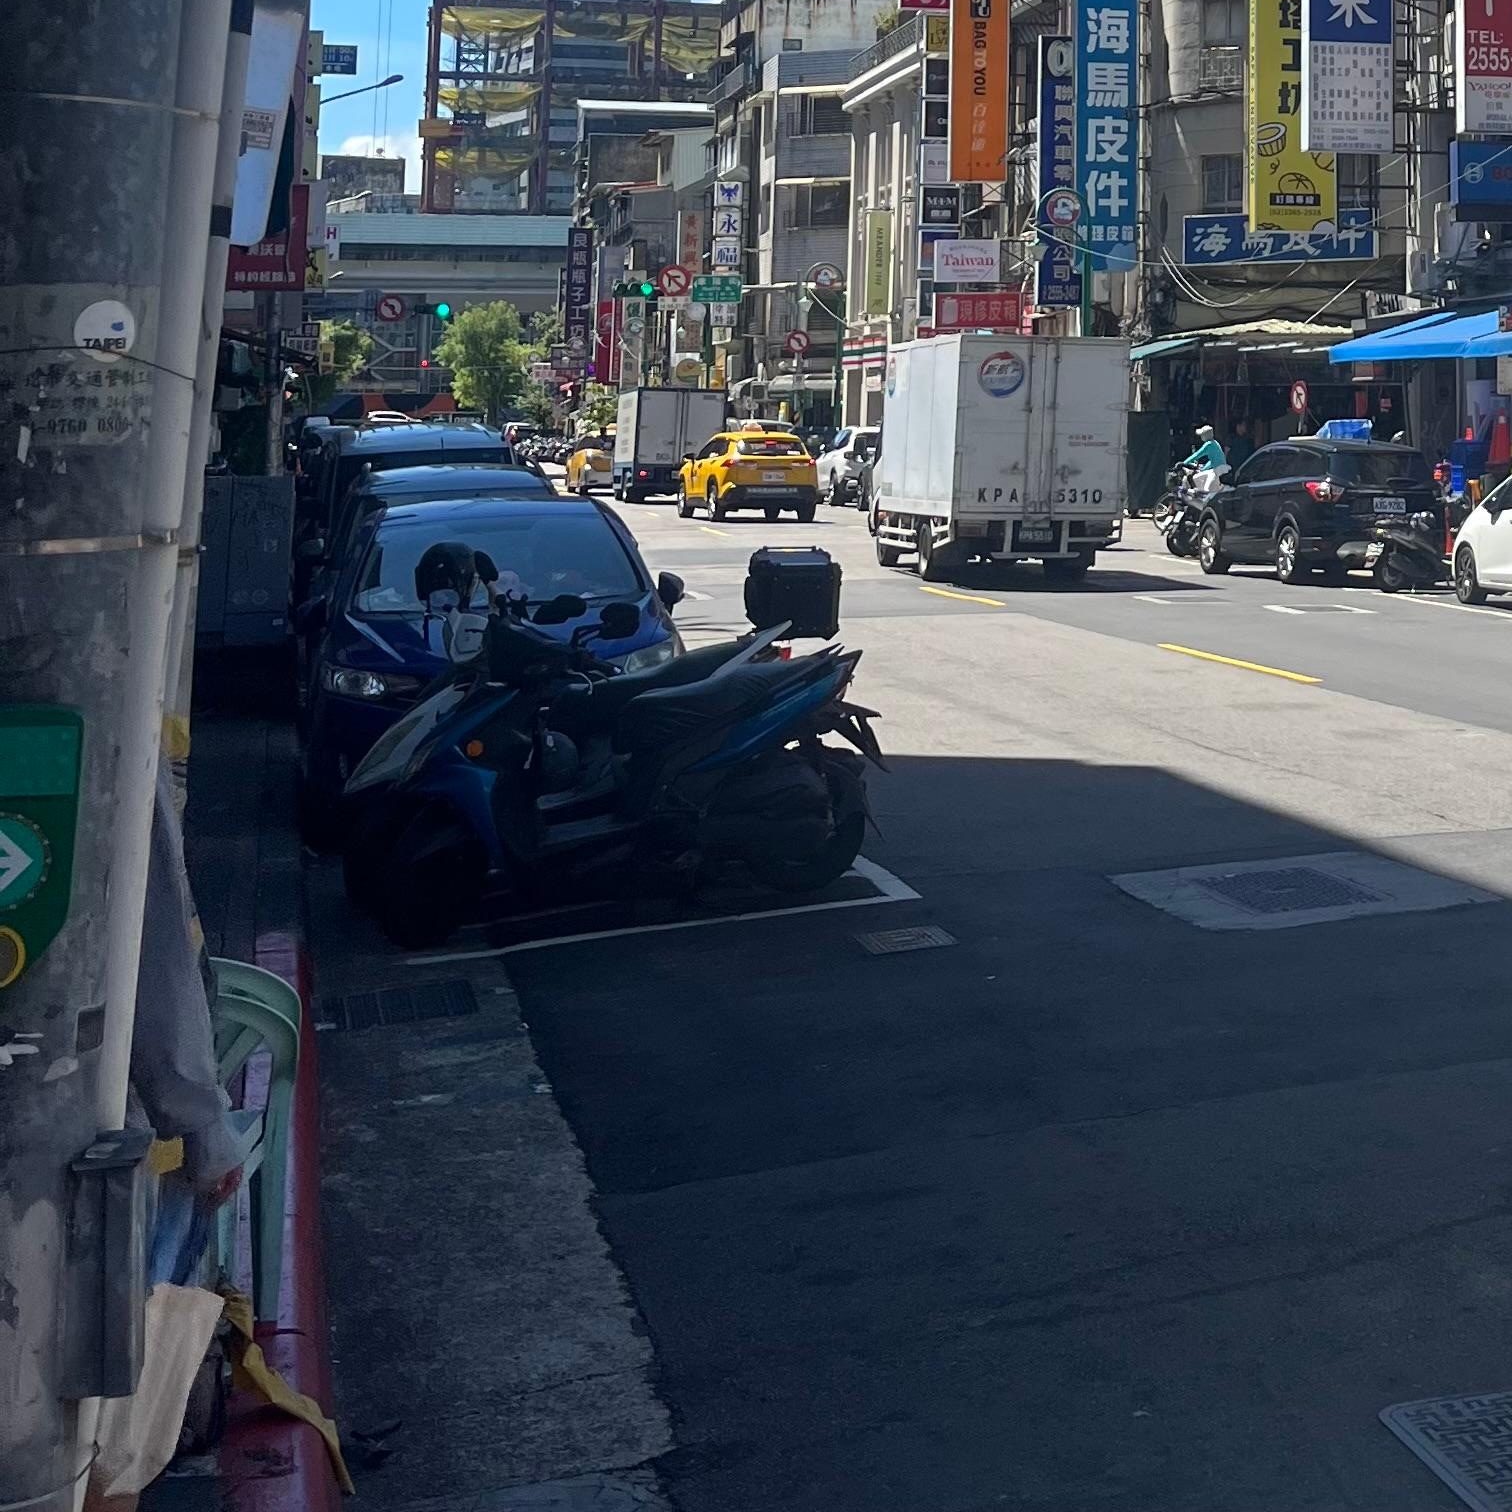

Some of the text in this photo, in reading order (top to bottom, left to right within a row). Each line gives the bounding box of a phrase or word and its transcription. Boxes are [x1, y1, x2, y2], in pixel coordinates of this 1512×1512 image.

[1085, 7, 1130, 219] 海馬皮件
[941, 253, 994, 266] Taiwan
[83, 337, 126, 350] TAIPEI
